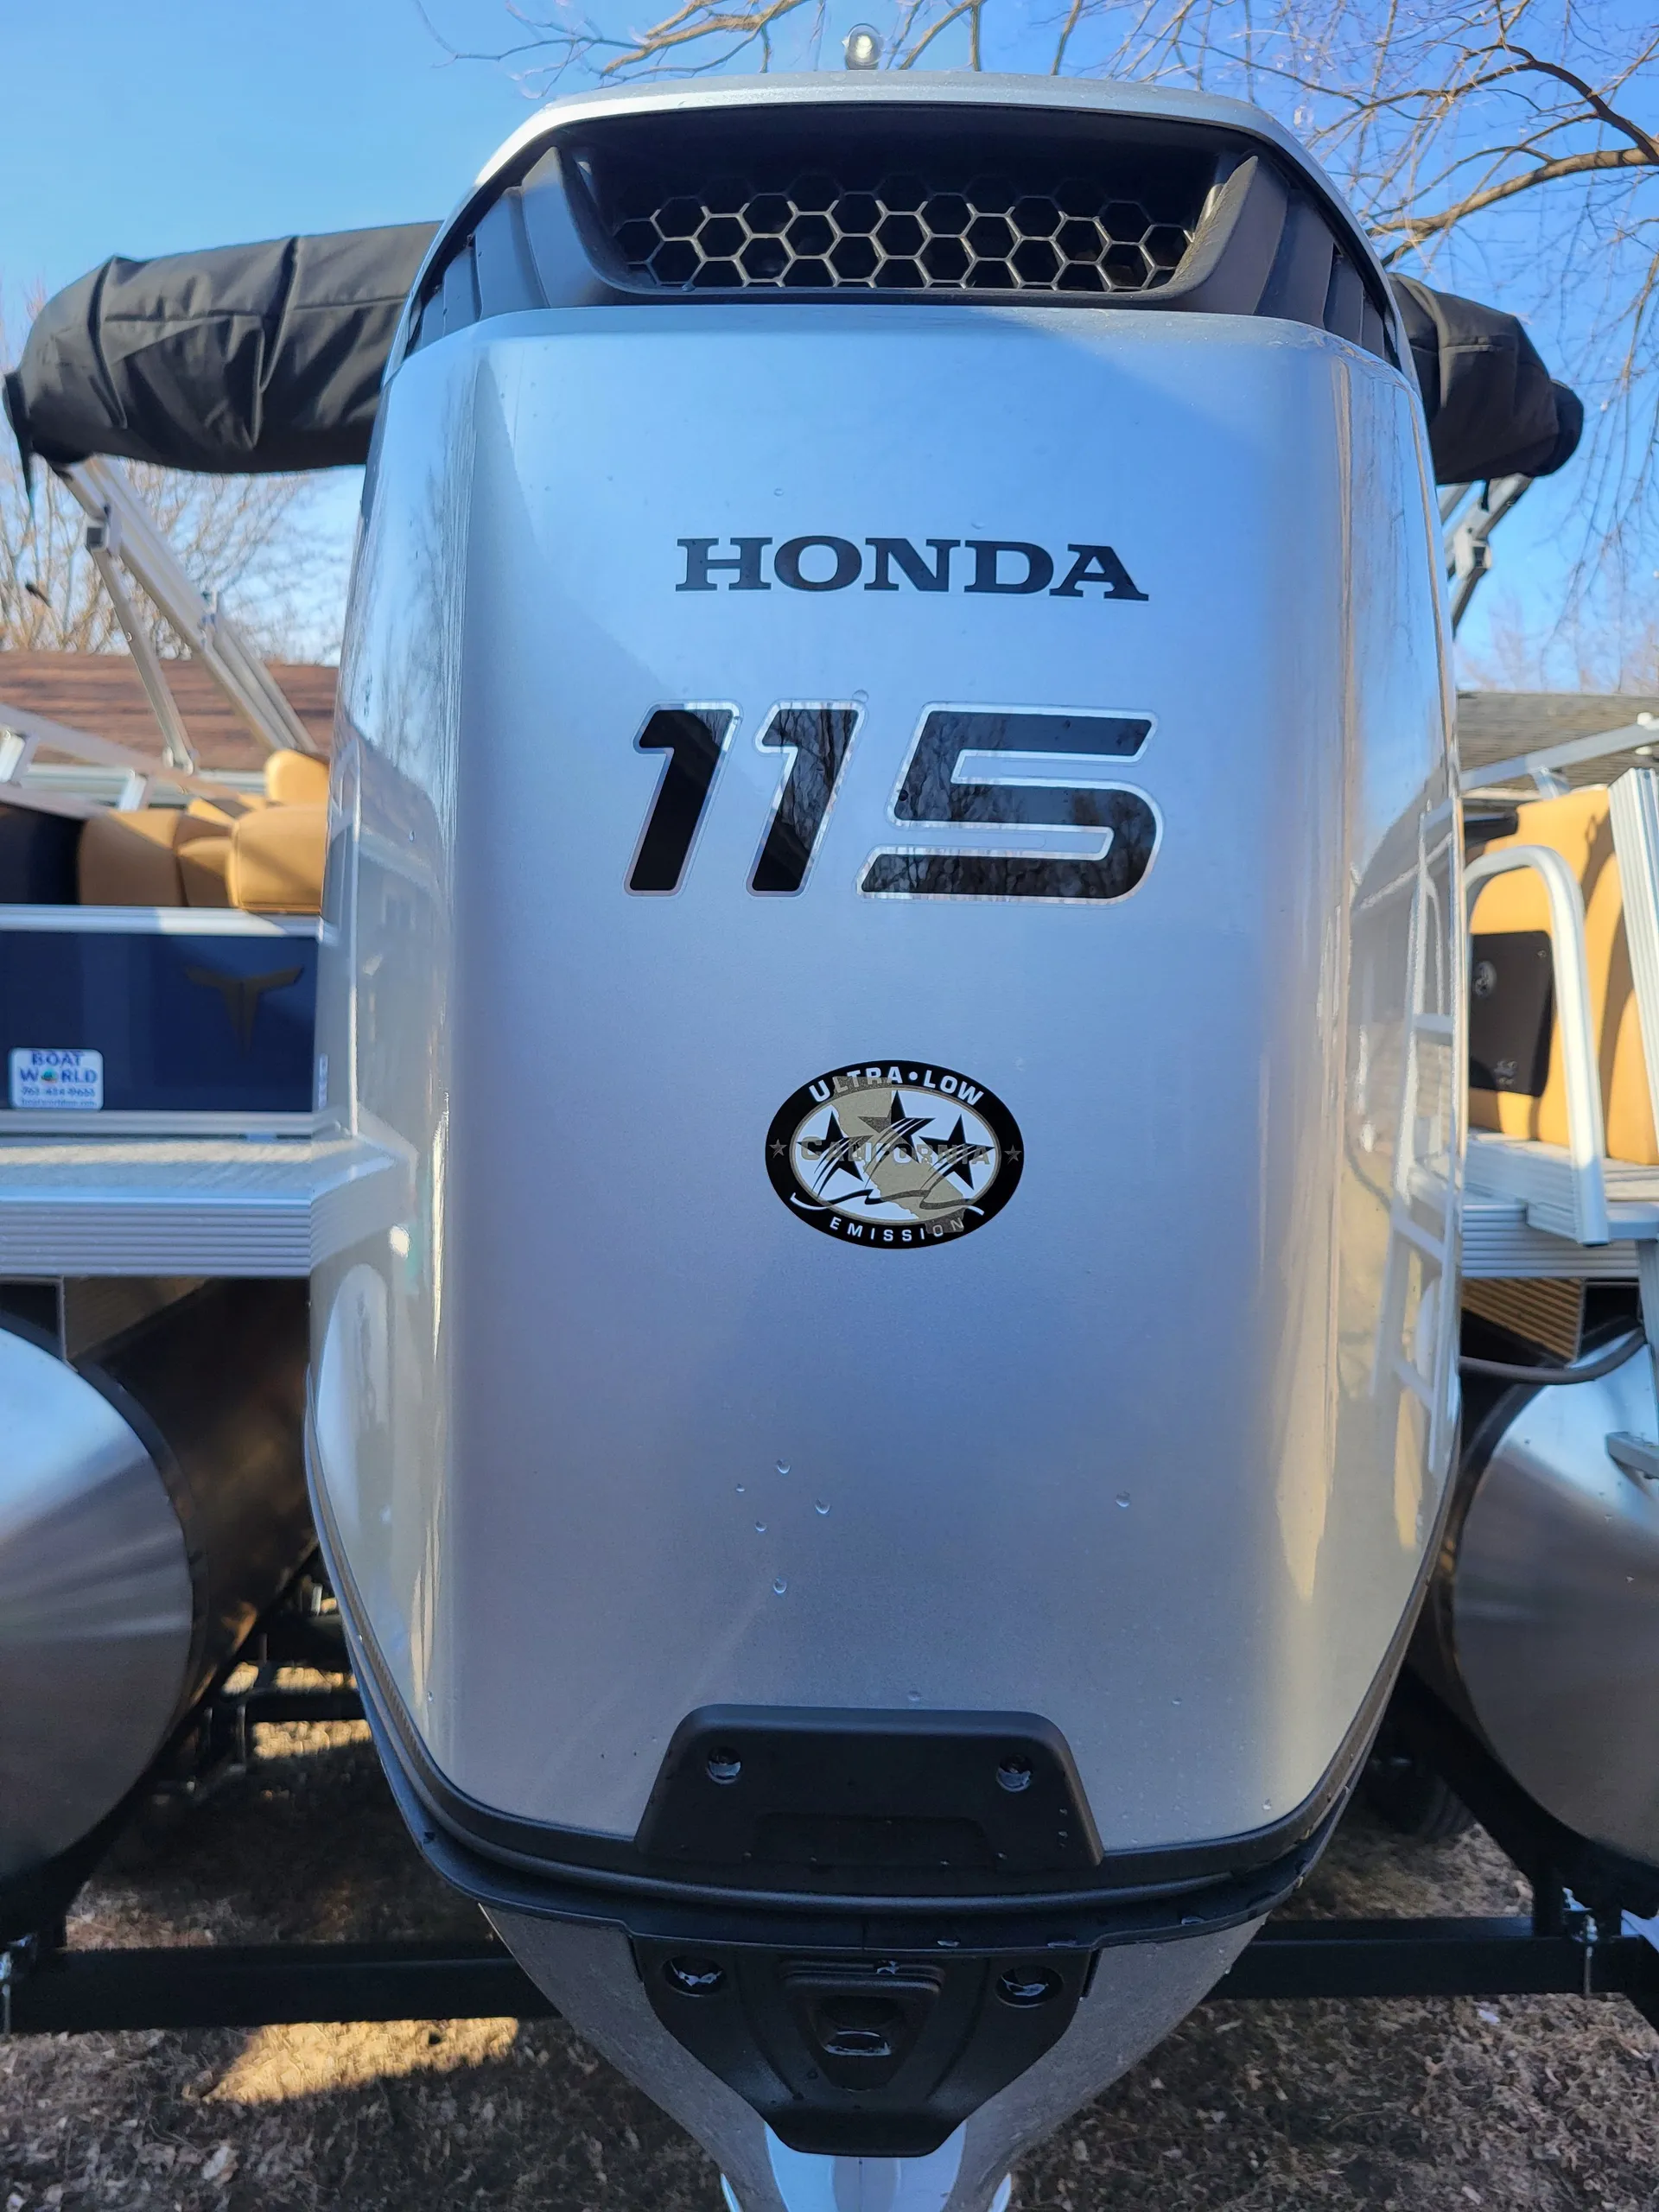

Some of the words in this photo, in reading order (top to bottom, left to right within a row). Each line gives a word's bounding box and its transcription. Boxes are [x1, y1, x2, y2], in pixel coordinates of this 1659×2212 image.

[676, 535, 1150, 601] HONDA
[624, 700, 1165, 905] 115
[31, 1050, 85, 1066] BOAT
[800, 1136, 991, 1166] CALIFORNIA
[830, 1217, 964, 1242] EMISSION
